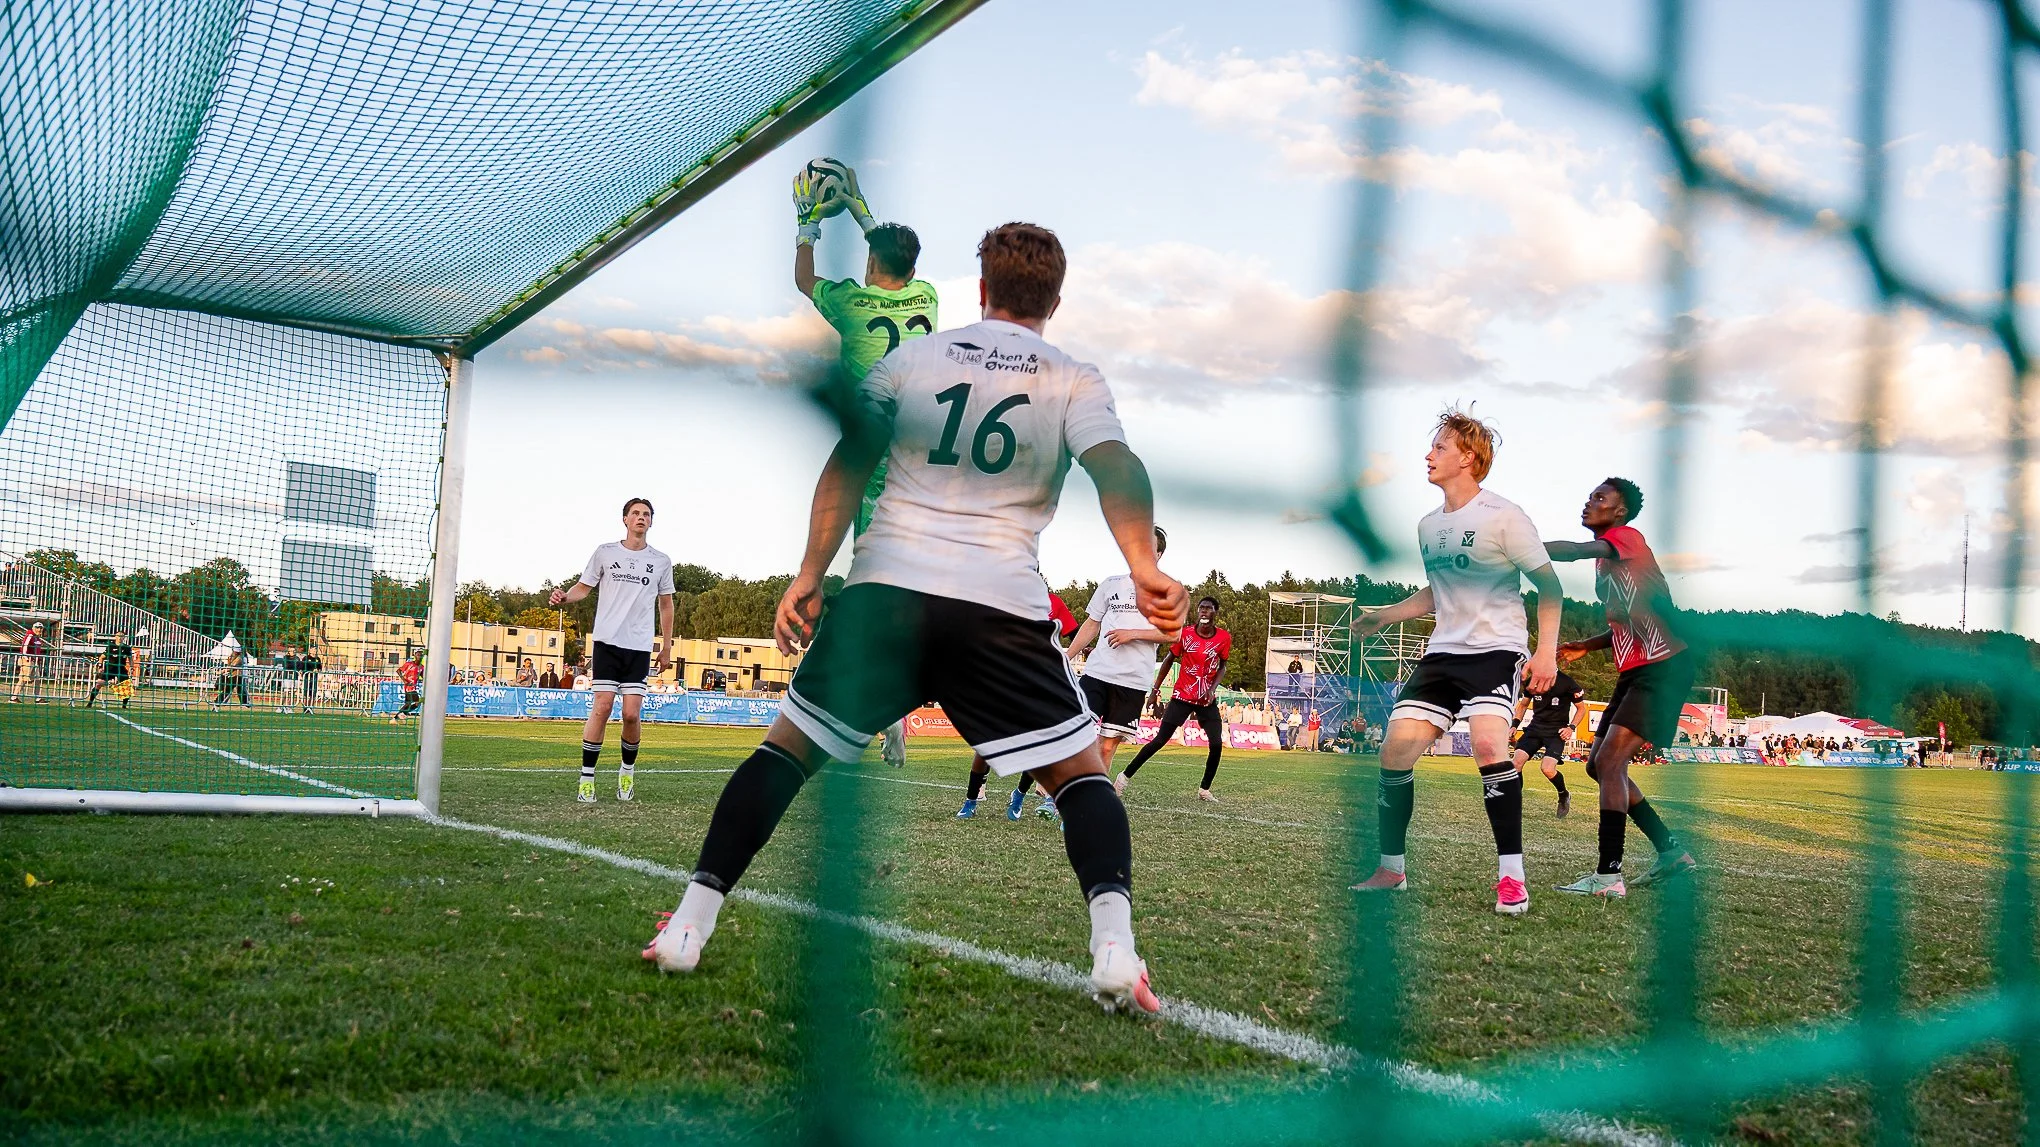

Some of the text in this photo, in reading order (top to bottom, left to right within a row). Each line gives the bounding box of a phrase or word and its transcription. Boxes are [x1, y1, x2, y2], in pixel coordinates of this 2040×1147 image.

[988, 346, 1038, 363] Åsen &
[985, 361, 1038, 375] Øvrelid
[927, 382, 1031, 475] 16
[463, 696, 486, 704] CUP
[642, 702, 662, 710] CUP
[697, 705, 717, 713] CUP
[749, 707, 768, 715] CUP
[1233, 729, 1277, 744] SPOND
